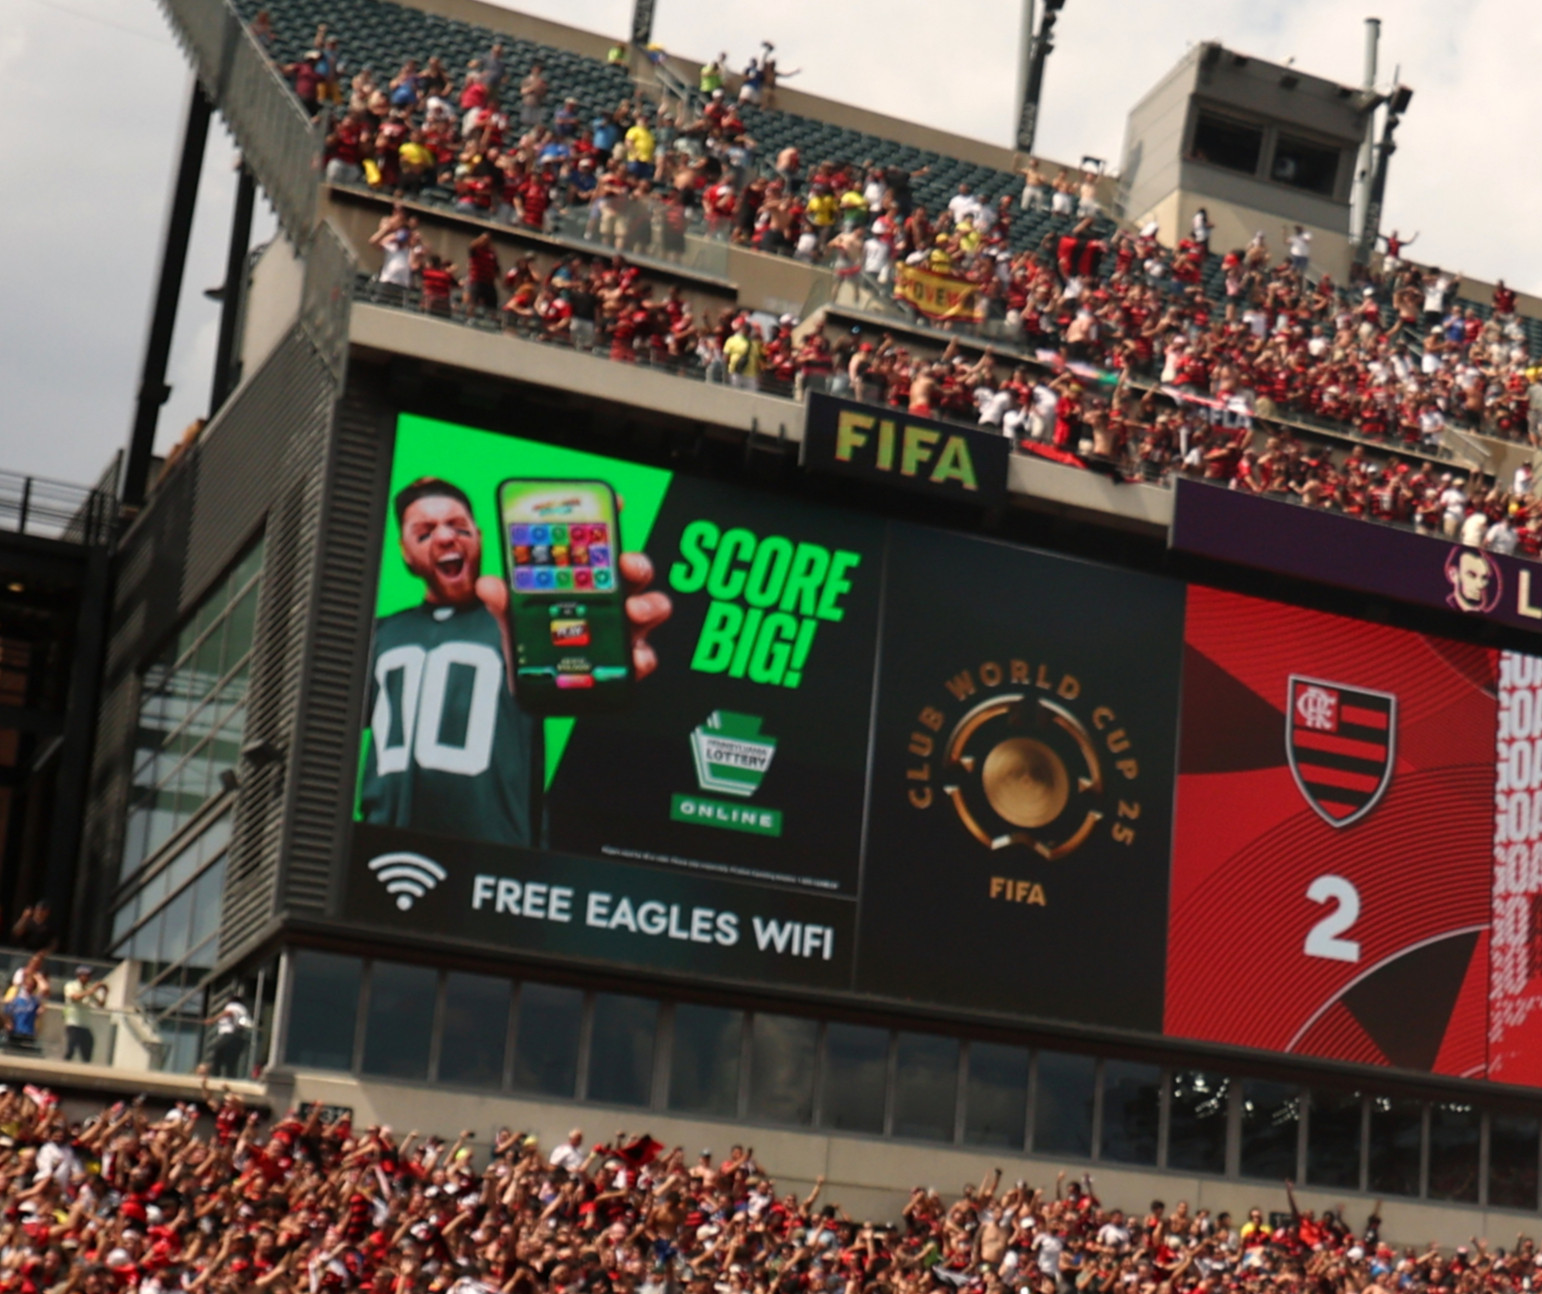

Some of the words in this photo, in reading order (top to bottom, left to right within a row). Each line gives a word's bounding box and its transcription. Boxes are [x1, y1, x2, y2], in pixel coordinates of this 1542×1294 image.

[834, 410, 979, 491] FIFA
[668, 520, 861, 622] SCORE
[690, 600, 818, 689] BIG!
[944, 659, 1081, 702] WORLD
[706, 749, 766, 769] LOTTERY
[908, 706, 945, 810] CLUB
[1093, 706, 1140, 782] CUP
[680, 801, 773, 828] ONLINE
[1111, 799, 1141, 847] 25
[472, 875, 574, 922] FREE
[586, 892, 740, 947] EAGLES
[752, 916, 834, 960] WIFI
[989, 876, 1047, 906] FIFA
[1303, 874, 1362, 964] 2
